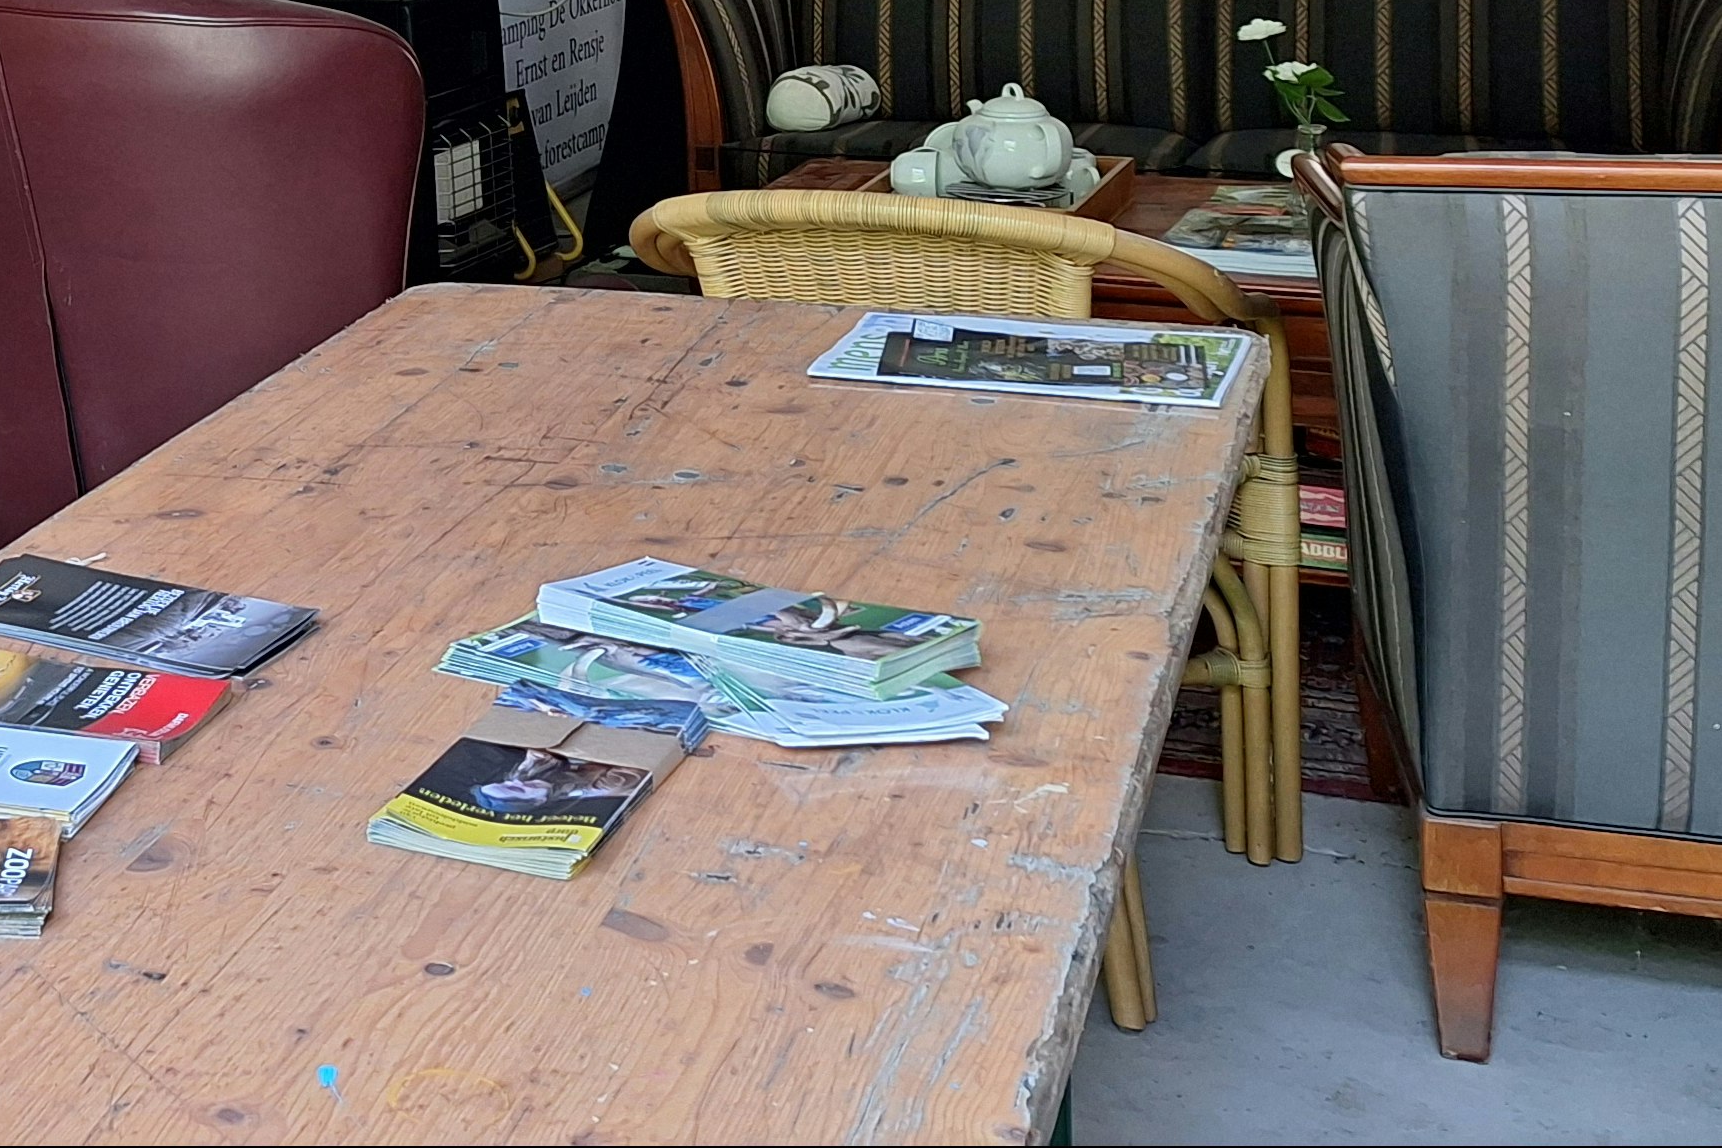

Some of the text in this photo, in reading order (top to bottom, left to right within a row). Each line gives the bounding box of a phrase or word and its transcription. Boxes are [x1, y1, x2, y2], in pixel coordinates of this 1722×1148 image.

[502, 10, 546, 49] amping
[549, 0, 566, 29] De
[515, 29, 605, 89] Ernst en Rensje
[530, 78, 598, 127] van Leijden
[418, 787, 496, 818] verleden
